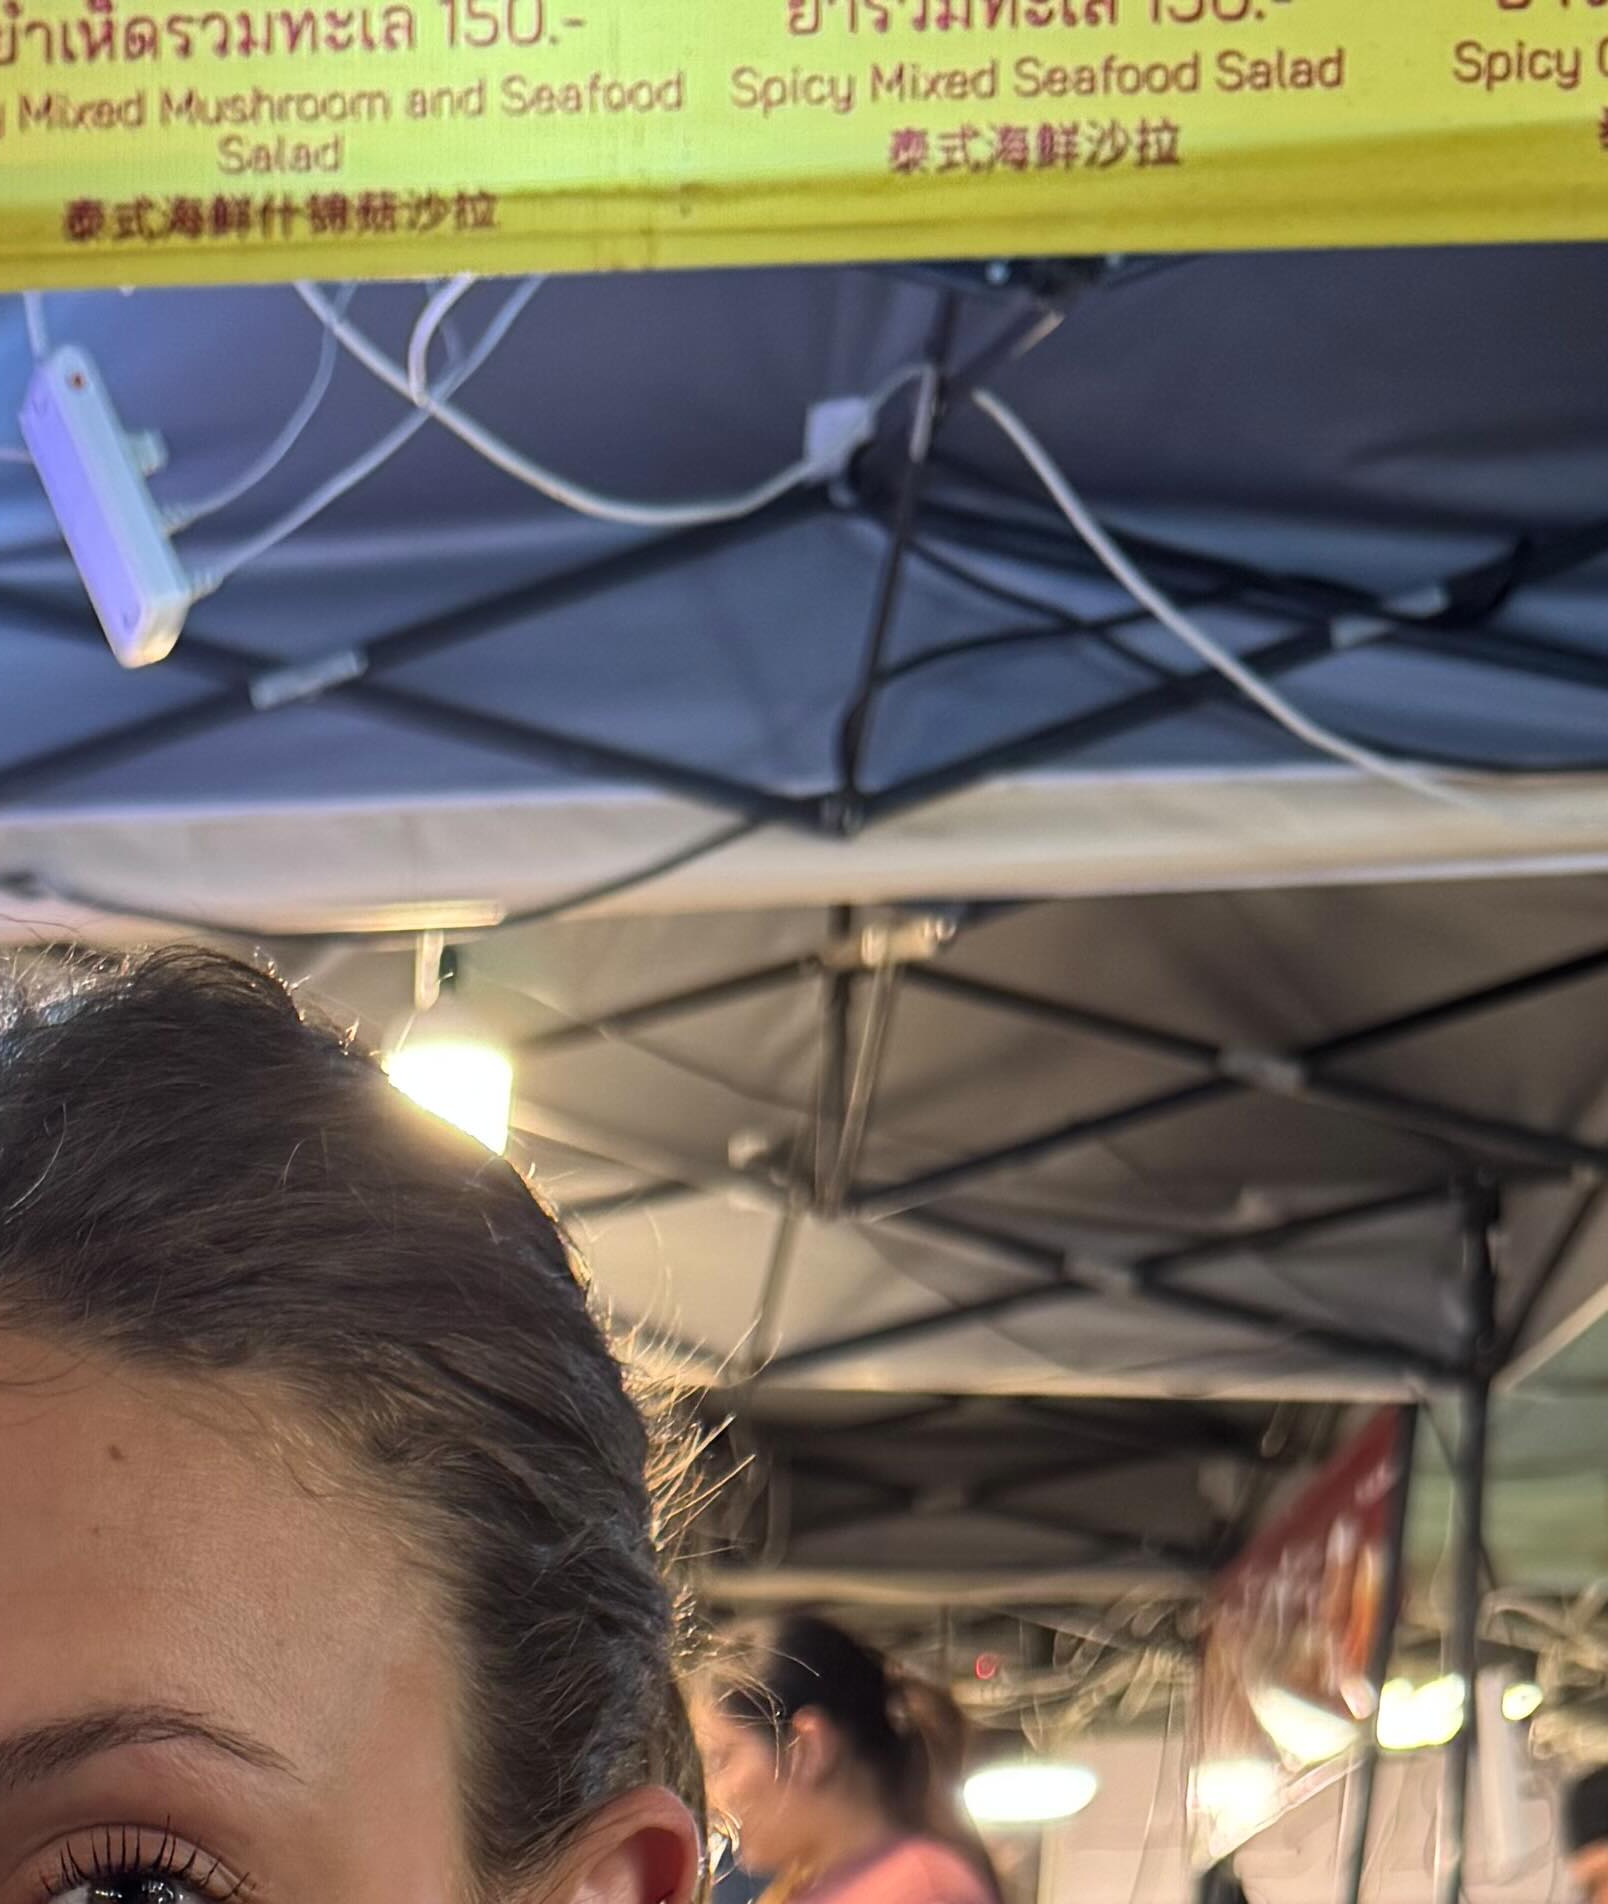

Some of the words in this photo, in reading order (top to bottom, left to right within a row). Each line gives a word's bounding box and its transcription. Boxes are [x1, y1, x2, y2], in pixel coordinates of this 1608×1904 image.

[439, 0, 587, 49] 150.-
[731, 66, 856, 114] Spicy
[870, 59, 998, 103] Mixed
[1013, 51, 1200, 99] Seafood
[1214, 47, 1346, 93] Salad
[1453, 39, 1582, 92] Spicy
[18, 90, 145, 134] Mixed
[158, 83, 391, 129] Mushroom
[404, 76, 486, 119] and
[501, 70, 685, 118] Seafood
[217, 133, 344, 177] Salad
